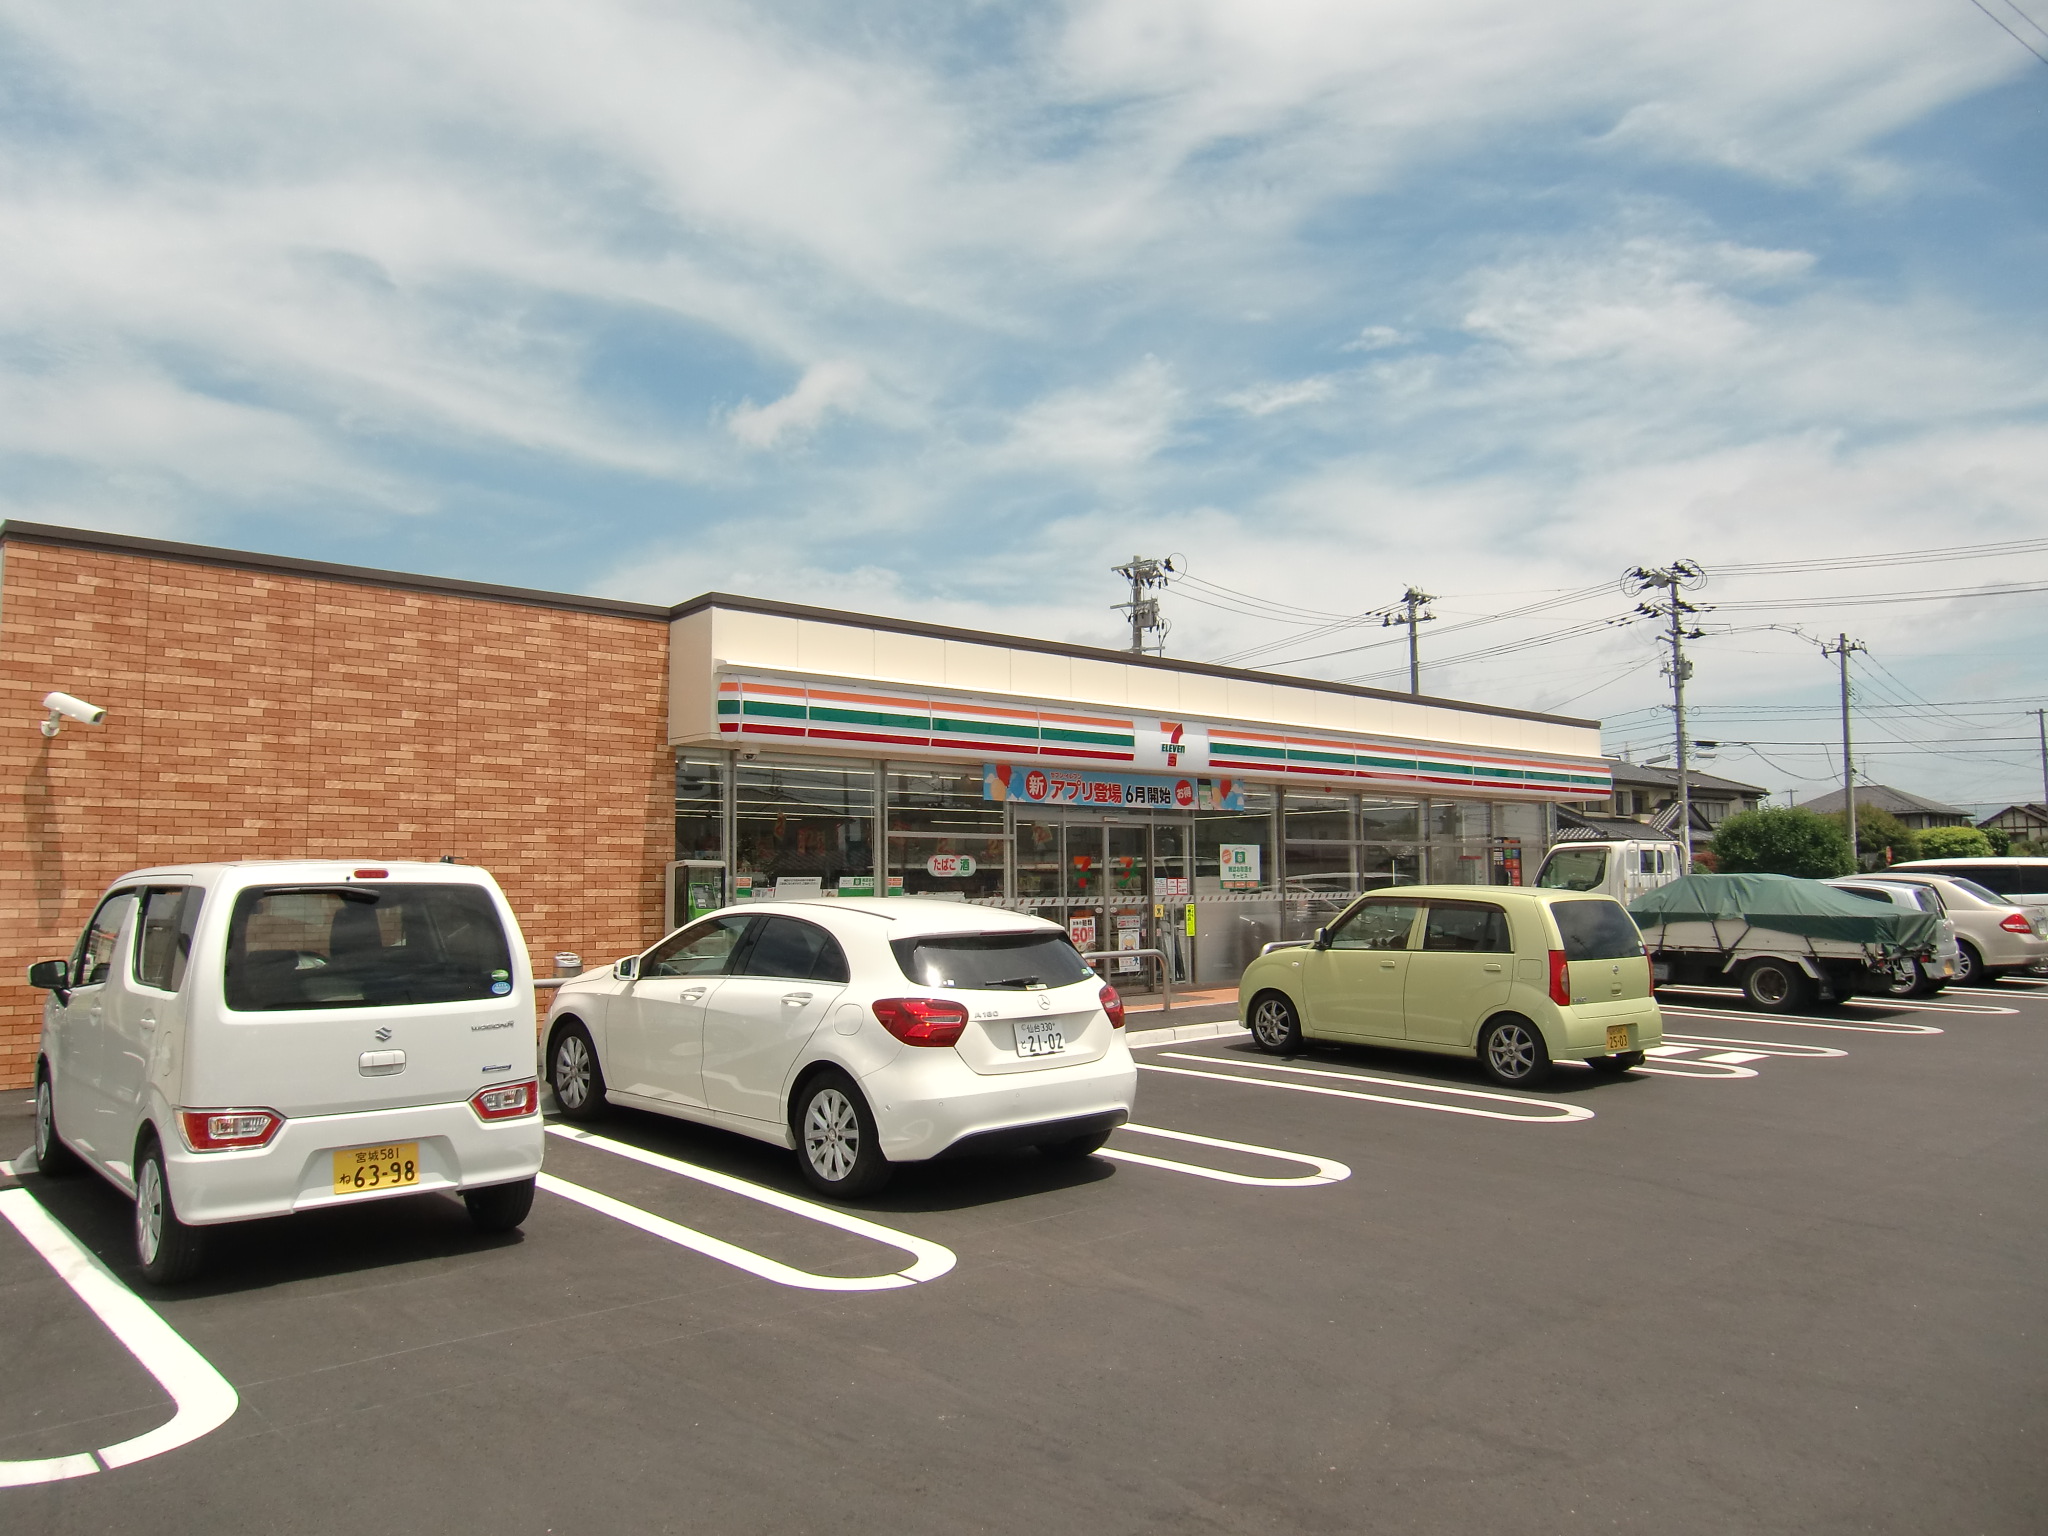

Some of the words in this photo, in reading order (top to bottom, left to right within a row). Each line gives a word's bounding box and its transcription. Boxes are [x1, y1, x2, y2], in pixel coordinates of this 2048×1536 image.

[1028, 775, 1045, 795] 新
[1051, 780, 1122, 804] アプリ登場
[1126, 786, 1171, 804] 6月開始
[1176, 786, 1192, 800] お得
[934, 858, 956, 871] たばこ
[960, 858, 970, 871] 酒
[1028, 1033, 1064, 1052] 21-02
[1609, 1034, 1628, 1049] 25-03
[339, 1173, 351, 1185] ね
[354, 1160, 415, 1188] 63-98
